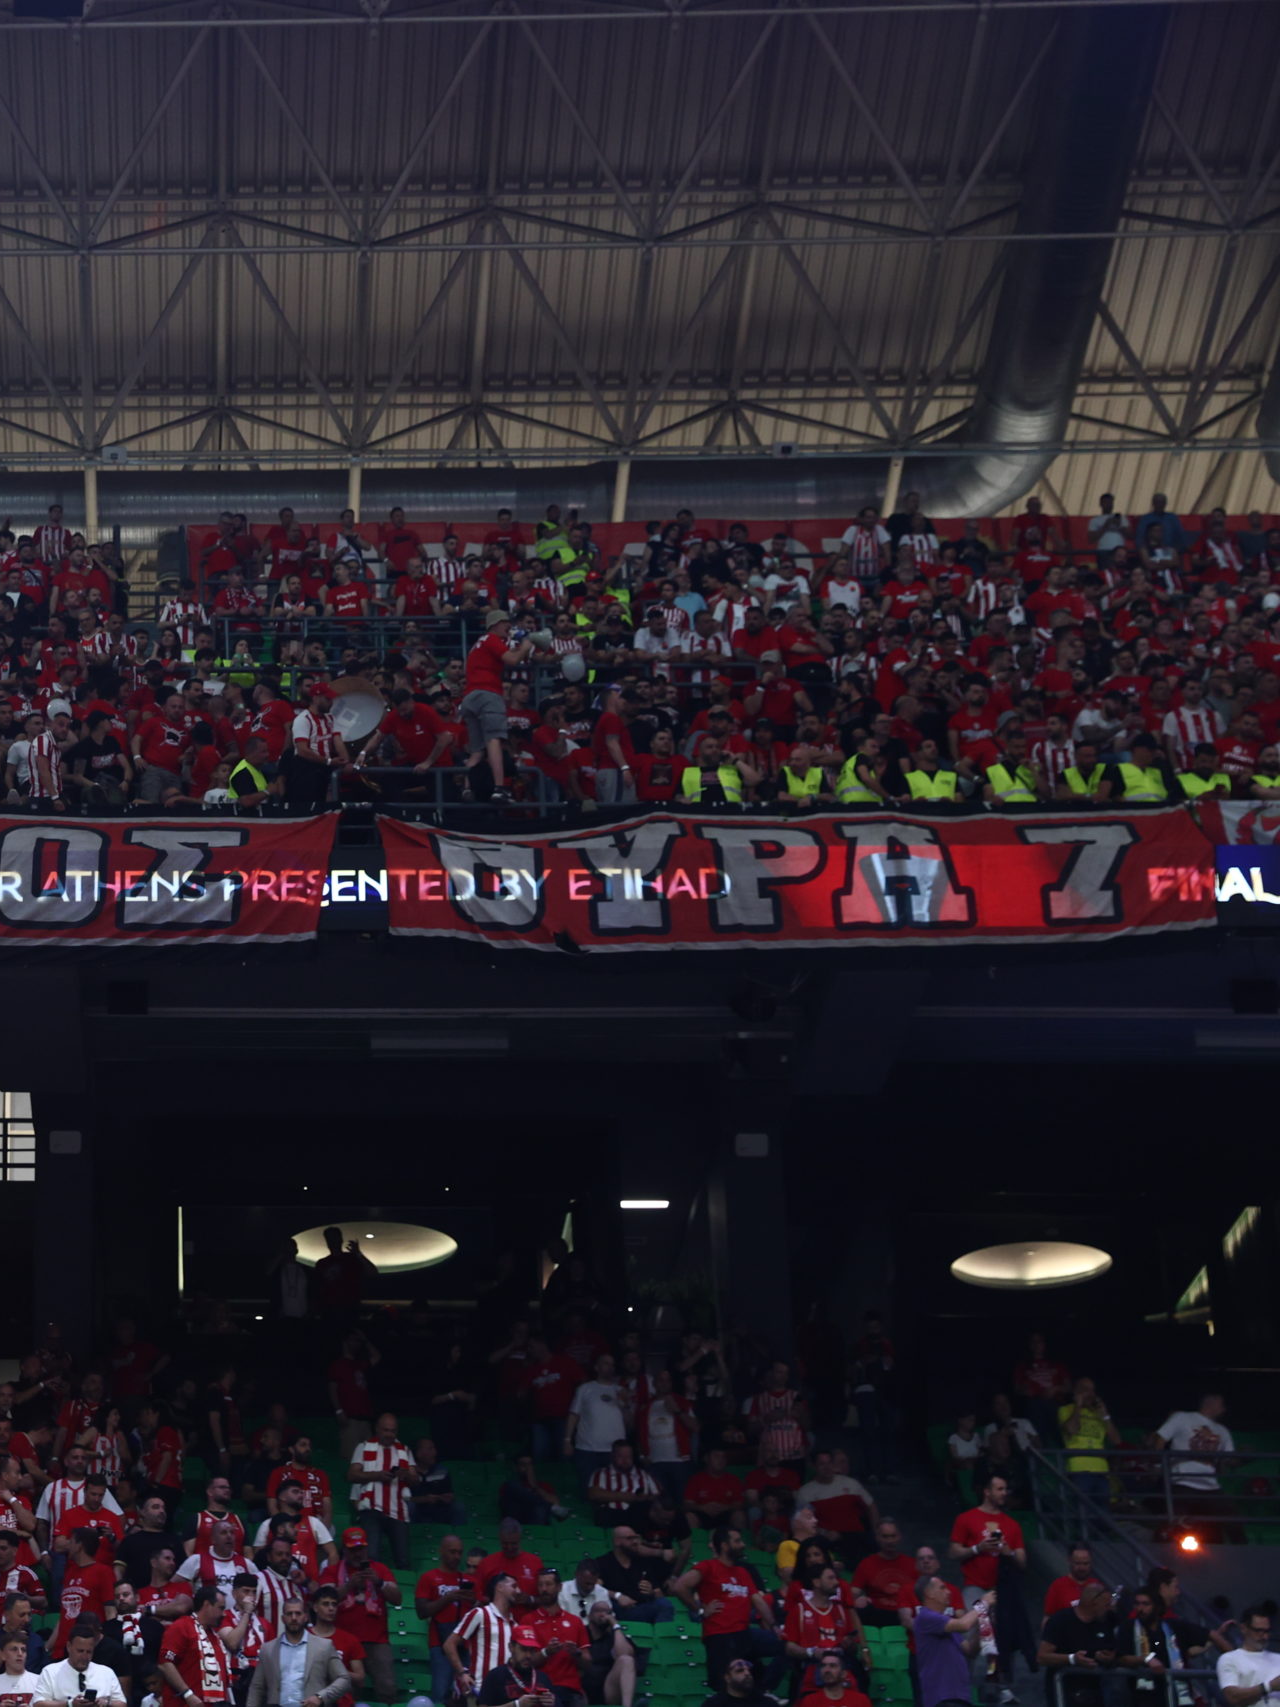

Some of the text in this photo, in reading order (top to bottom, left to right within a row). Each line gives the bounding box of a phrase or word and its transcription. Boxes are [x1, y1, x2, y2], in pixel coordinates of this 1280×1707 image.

[36, 869, 207, 903] ATHENS
[223, 868, 475, 907] PRESENTED
[492, 868, 553, 902] BY
[567, 867, 732, 901] ETIHAD
[1019, 820, 1140, 926] 7
